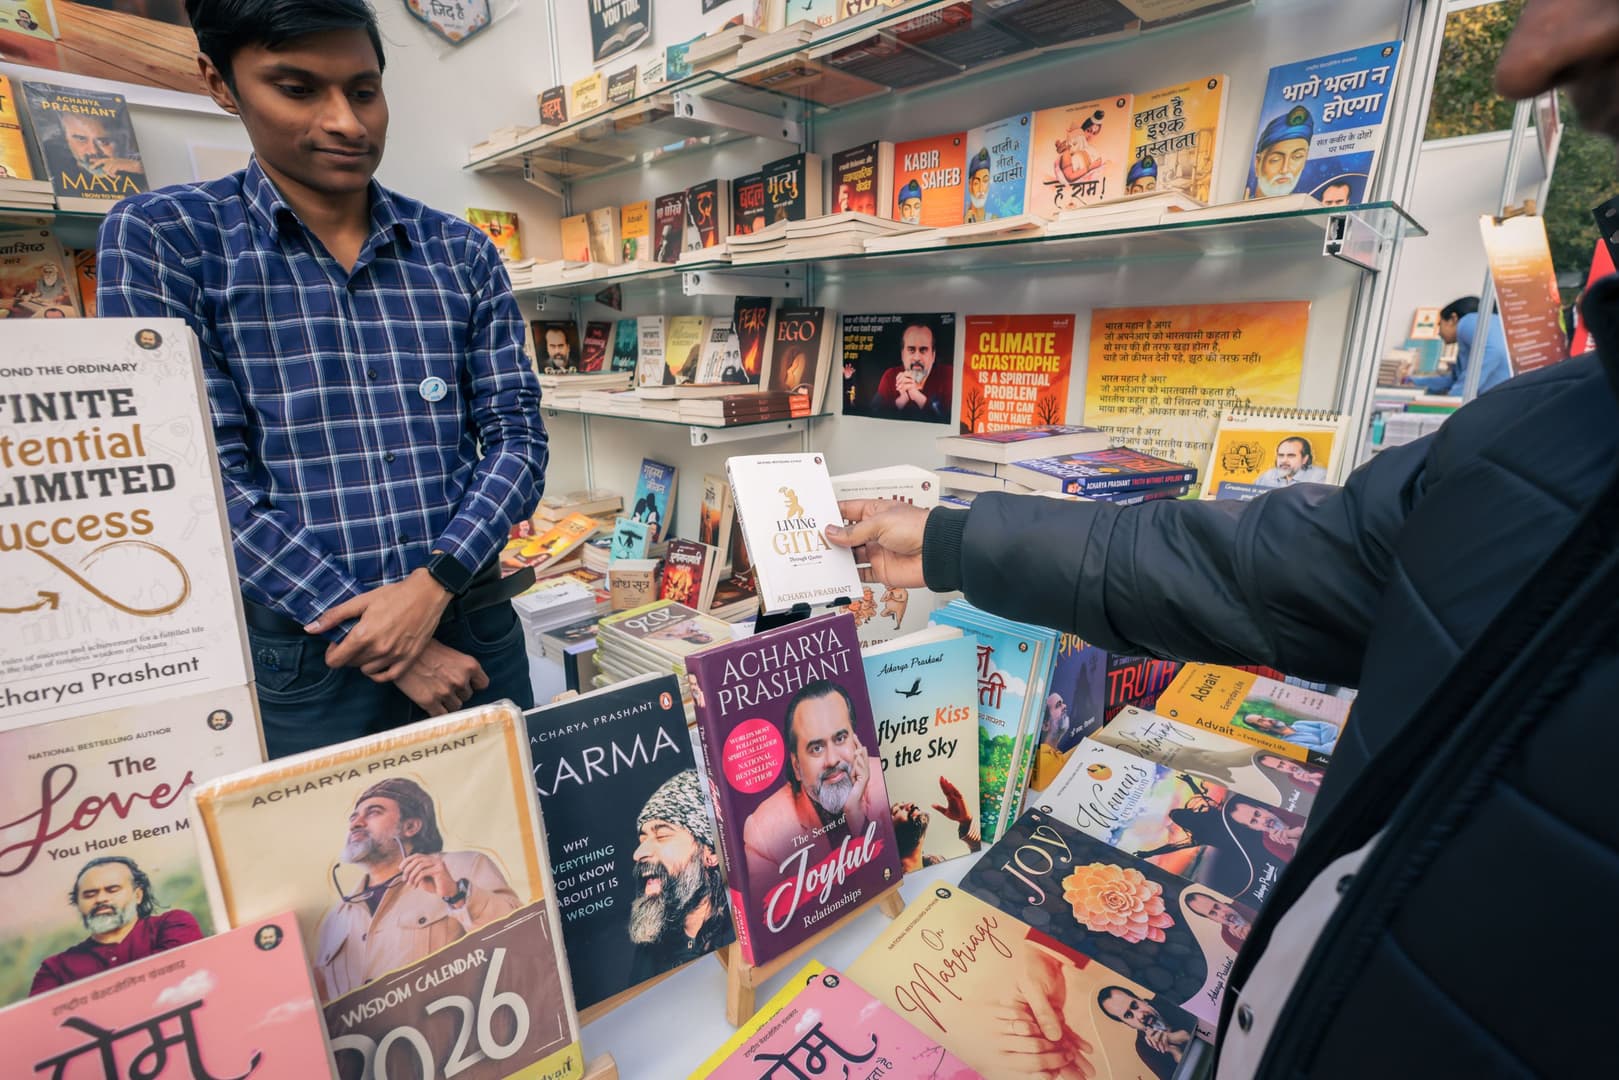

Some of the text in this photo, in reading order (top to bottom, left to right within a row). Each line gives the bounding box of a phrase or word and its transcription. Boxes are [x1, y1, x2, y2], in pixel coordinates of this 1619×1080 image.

[602, 4, 621, 28] YOU
[816, 15, 833, 26] Kiss
[1283, 66, 1390, 101] भागे भला न
[42, 101, 117, 118] PRASHANT
[56, 96, 100, 106] ACHARYA
[1134, 95, 1183, 129] हमन है
[1322, 93, 1383, 122] होएगा
[1147, 116, 1186, 140] इश्क
[992, 137, 1012, 155] पानी
[1135, 131, 1197, 159] मस्ताना
[903, 149, 941, 172] KABIR
[62, 171, 141, 194] MAYA
[767, 169, 800, 204] मृत्यु
[921, 168, 961, 191] SAHEB
[738, 308, 767, 330] FEAR
[777, 320, 816, 342] EGO
[1105, 322, 1122, 330] भारत
[1125, 321, 1144, 329] महान
[979, 332, 1056, 354] CLIMATE
[36, 366, 64, 376] THE
[69, 363, 138, 374] ORDINARY
[971, 353, 1060, 373] CATASTROPHE
[978, 371, 1050, 387] IS A SPIRITUAL
[1101, 375, 1119, 383] भारत
[1120, 375, 1138, 383] महान
[983, 385, 1037, 401] PROBLEM
[0, 388, 138, 424] INITE
[988, 401, 1034, 413] AND IT CAN
[988, 412, 1032, 424] ONLY HAVE
[777, 518, 816, 532] LIVING
[772, 529, 832, 556] GITA
[777, 585, 852, 603] ACHARYA PRASHANT
[25, 654, 34, 662] of
[70, 646, 86, 654] and
[45, 658, 54, 667] of
[92, 648, 124, 660] wisdom
[126, 646, 136, 655] of
[722, 628, 843, 686] ACHARYA
[877, 653, 944, 677] Acharya Prashant
[92, 657, 200, 690] Prashant
[717, 649, 851, 717] PRASHANT
[1107, 659, 1176, 706] TRUTH
[1190, 672, 1221, 703] Advait
[530, 702, 653, 746] ACHARYA PRASHANT
[753, 726, 771, 737] MOST
[878, 705, 970, 746] flying Kiss
[1195, 717, 1235, 737] Advait
[1243, 733, 1274, 750] Everyday
[28, 727, 172, 761] NATIONAL BESTSELLING AUTHOR
[735, 735, 767, 750] FOLLOWED
[755, 739, 778, 753] LEADER
[895, 736, 958, 768] the Sky
[109, 756, 157, 778] The
[251, 734, 478, 809] ACHARYA PRASHANT
[532, 726, 681, 797] KARMA
[735, 760, 778, 780] BESTSELLING
[738, 752, 772, 770] NATIONAL
[745, 771, 774, 786] AUTHOR
[48, 823, 171, 861] You Have Been
[791, 813, 847, 848] The Secret of
[563, 837, 589, 854] WHY
[551, 845, 615, 876] VERYTHING
[579, 861, 616, 884] KNOW
[1001, 825, 1074, 907] JOY
[767, 821, 877, 933] Joyful
[557, 877, 619, 909] ABOUT IT IS
[565, 896, 614, 922] WRONG
[803, 887, 862, 928] Relationships
[921, 928, 945, 952] On
[895, 915, 1013, 1034] Marriage
[341, 949, 488, 1028] WISDOM CALENDAR
